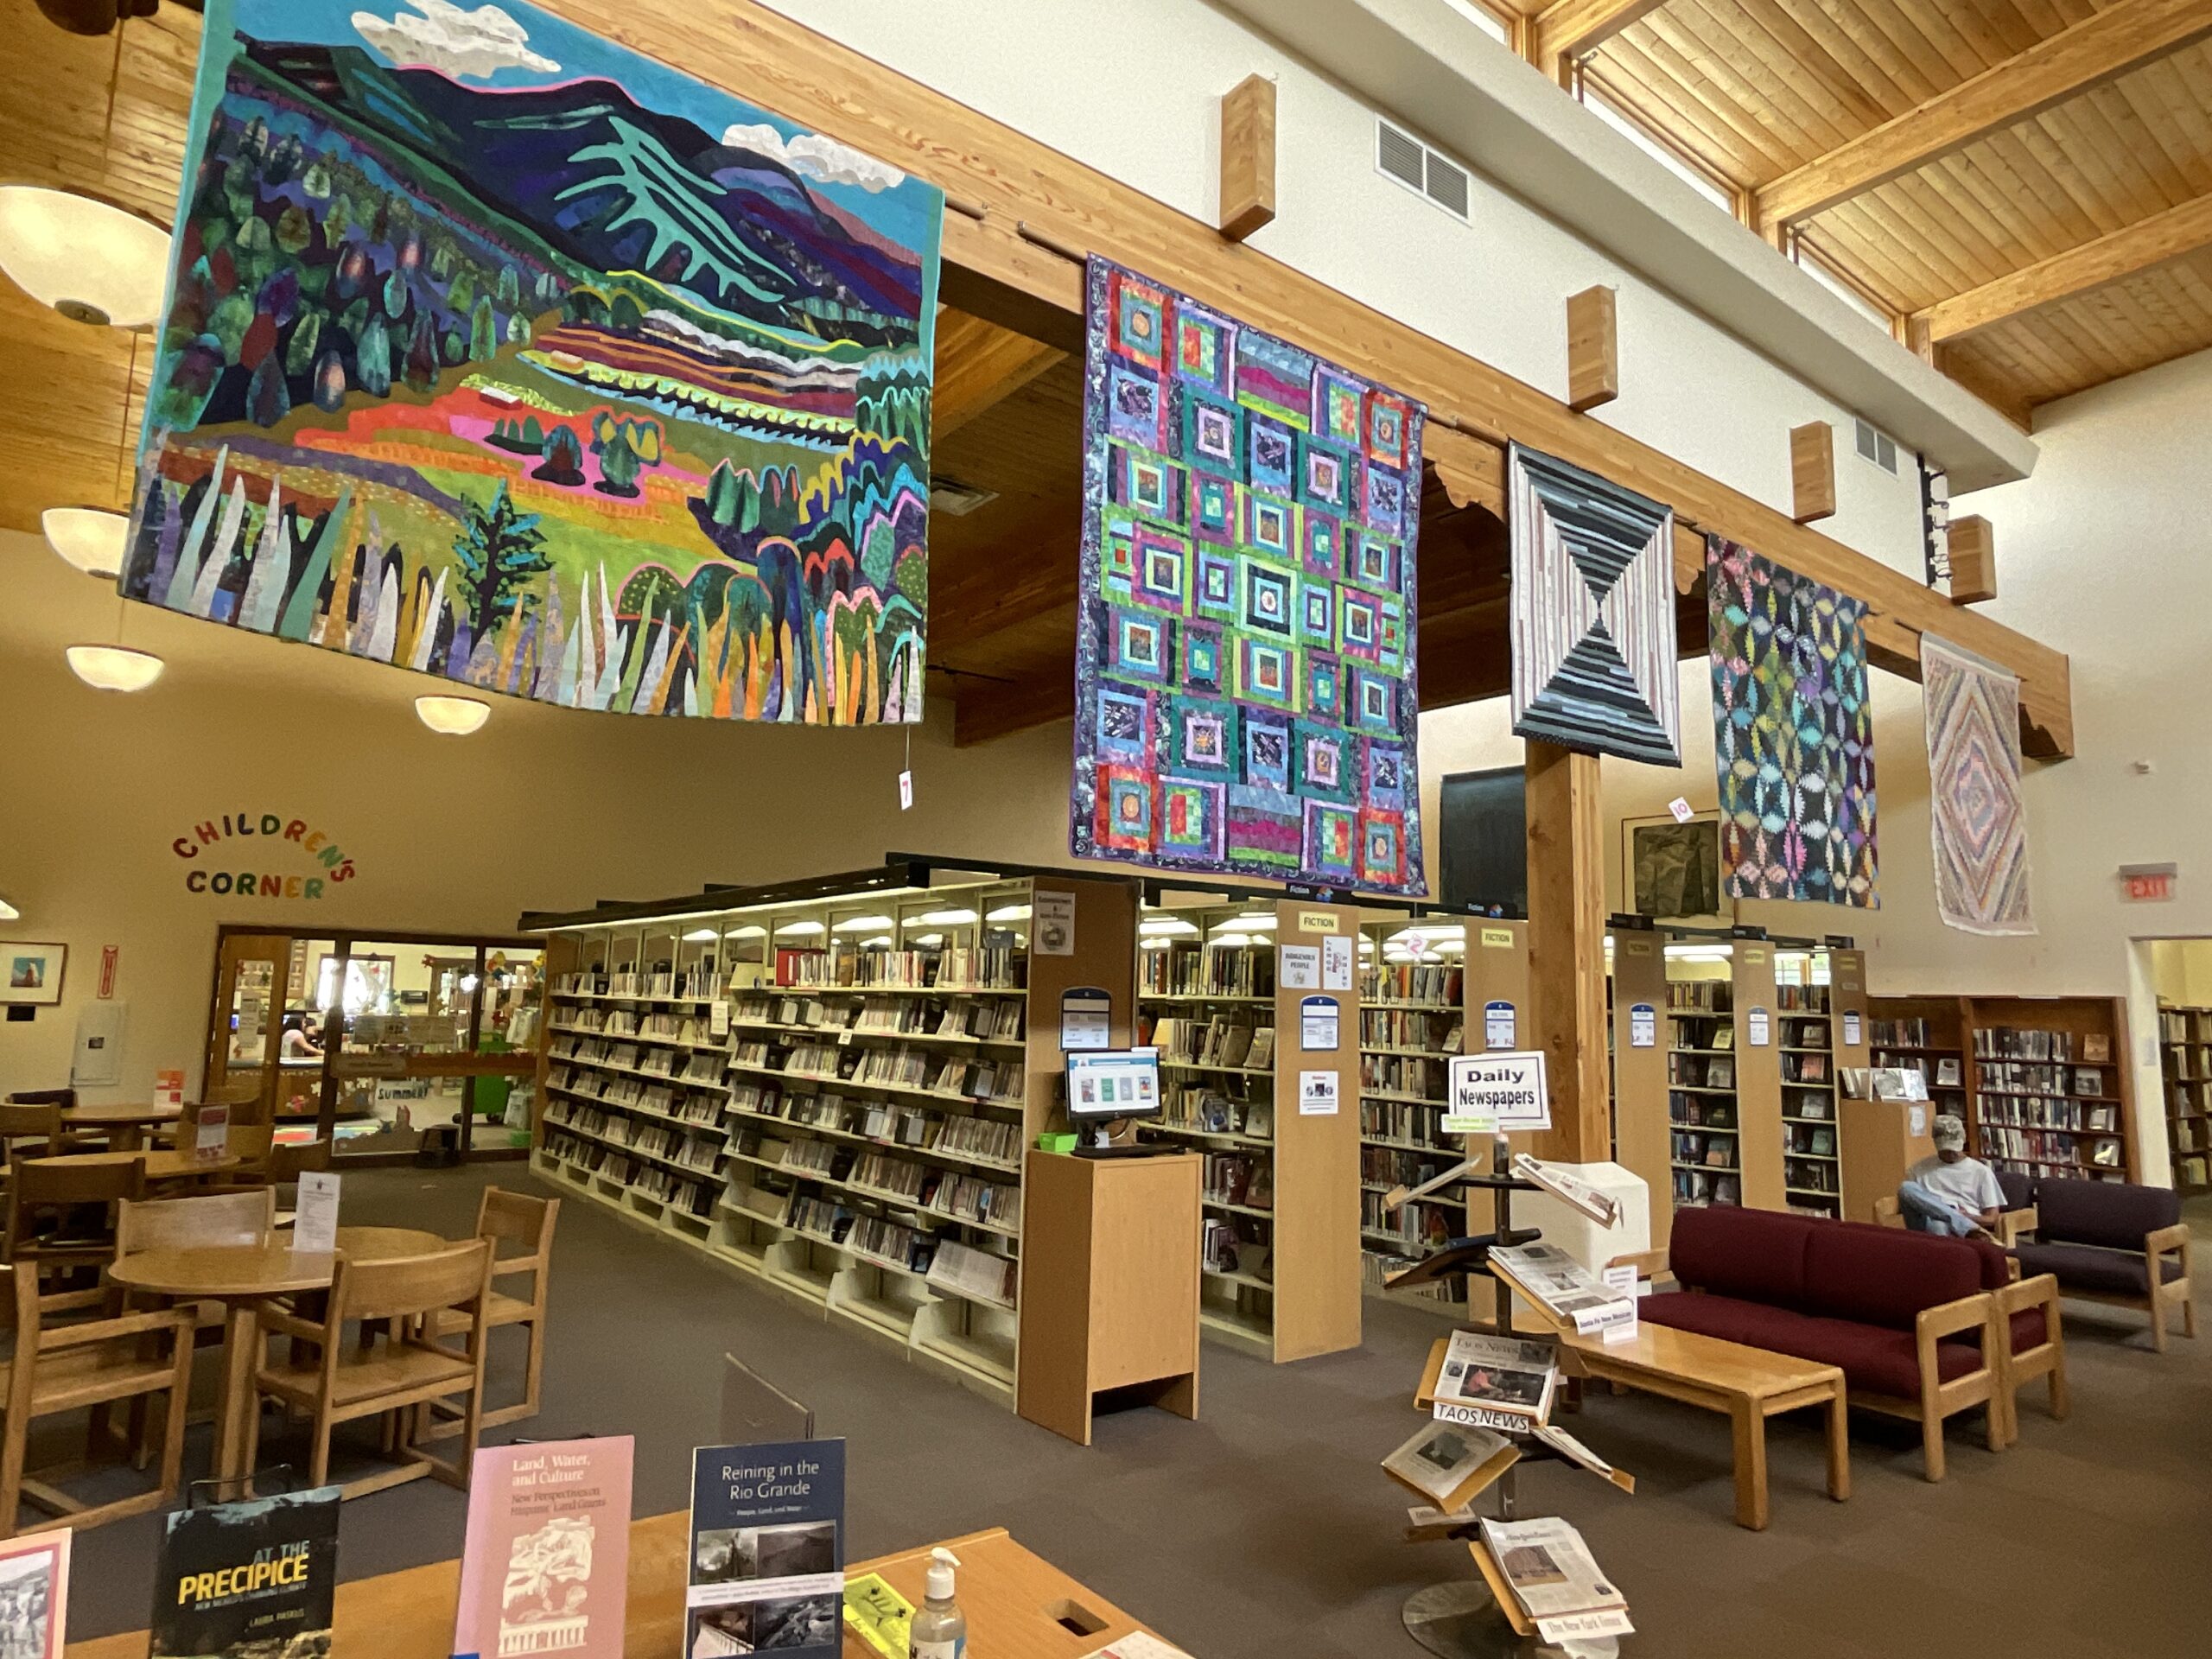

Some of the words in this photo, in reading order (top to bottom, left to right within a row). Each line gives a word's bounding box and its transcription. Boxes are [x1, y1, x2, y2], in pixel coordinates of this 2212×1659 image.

[173, 813, 355, 882] CHILDREN'S
[187, 871, 324, 899] CORNER
[2131, 874, 2167, 898] EXIT
[1304, 917, 1334, 927] FICTION
[1485, 933, 1510, 943] FICTION
[1467, 1069, 1524, 1084] Daily
[1459, 1088, 1535, 1110] Newspapers
[1439, 1403, 1478, 1424] TAOS
[1480, 1411, 1528, 1431] NEWS
[513, 1456, 548, 1471] Land,
[553, 1455, 591, 1467] Water,
[721, 1465, 776, 1482] Reining
[779, 1465, 793, 1477] in
[798, 1460, 819, 1475] the
[512, 1471, 536, 1486] and
[539, 1470, 584, 1484] Culture
[730, 1484, 753, 1500] Rio
[757, 1479, 810, 1498] Grande
[254, 1548, 273, 1564] AT
[280, 1541, 309, 1557] THE
[178, 1554, 308, 1605] PRECIPICE
